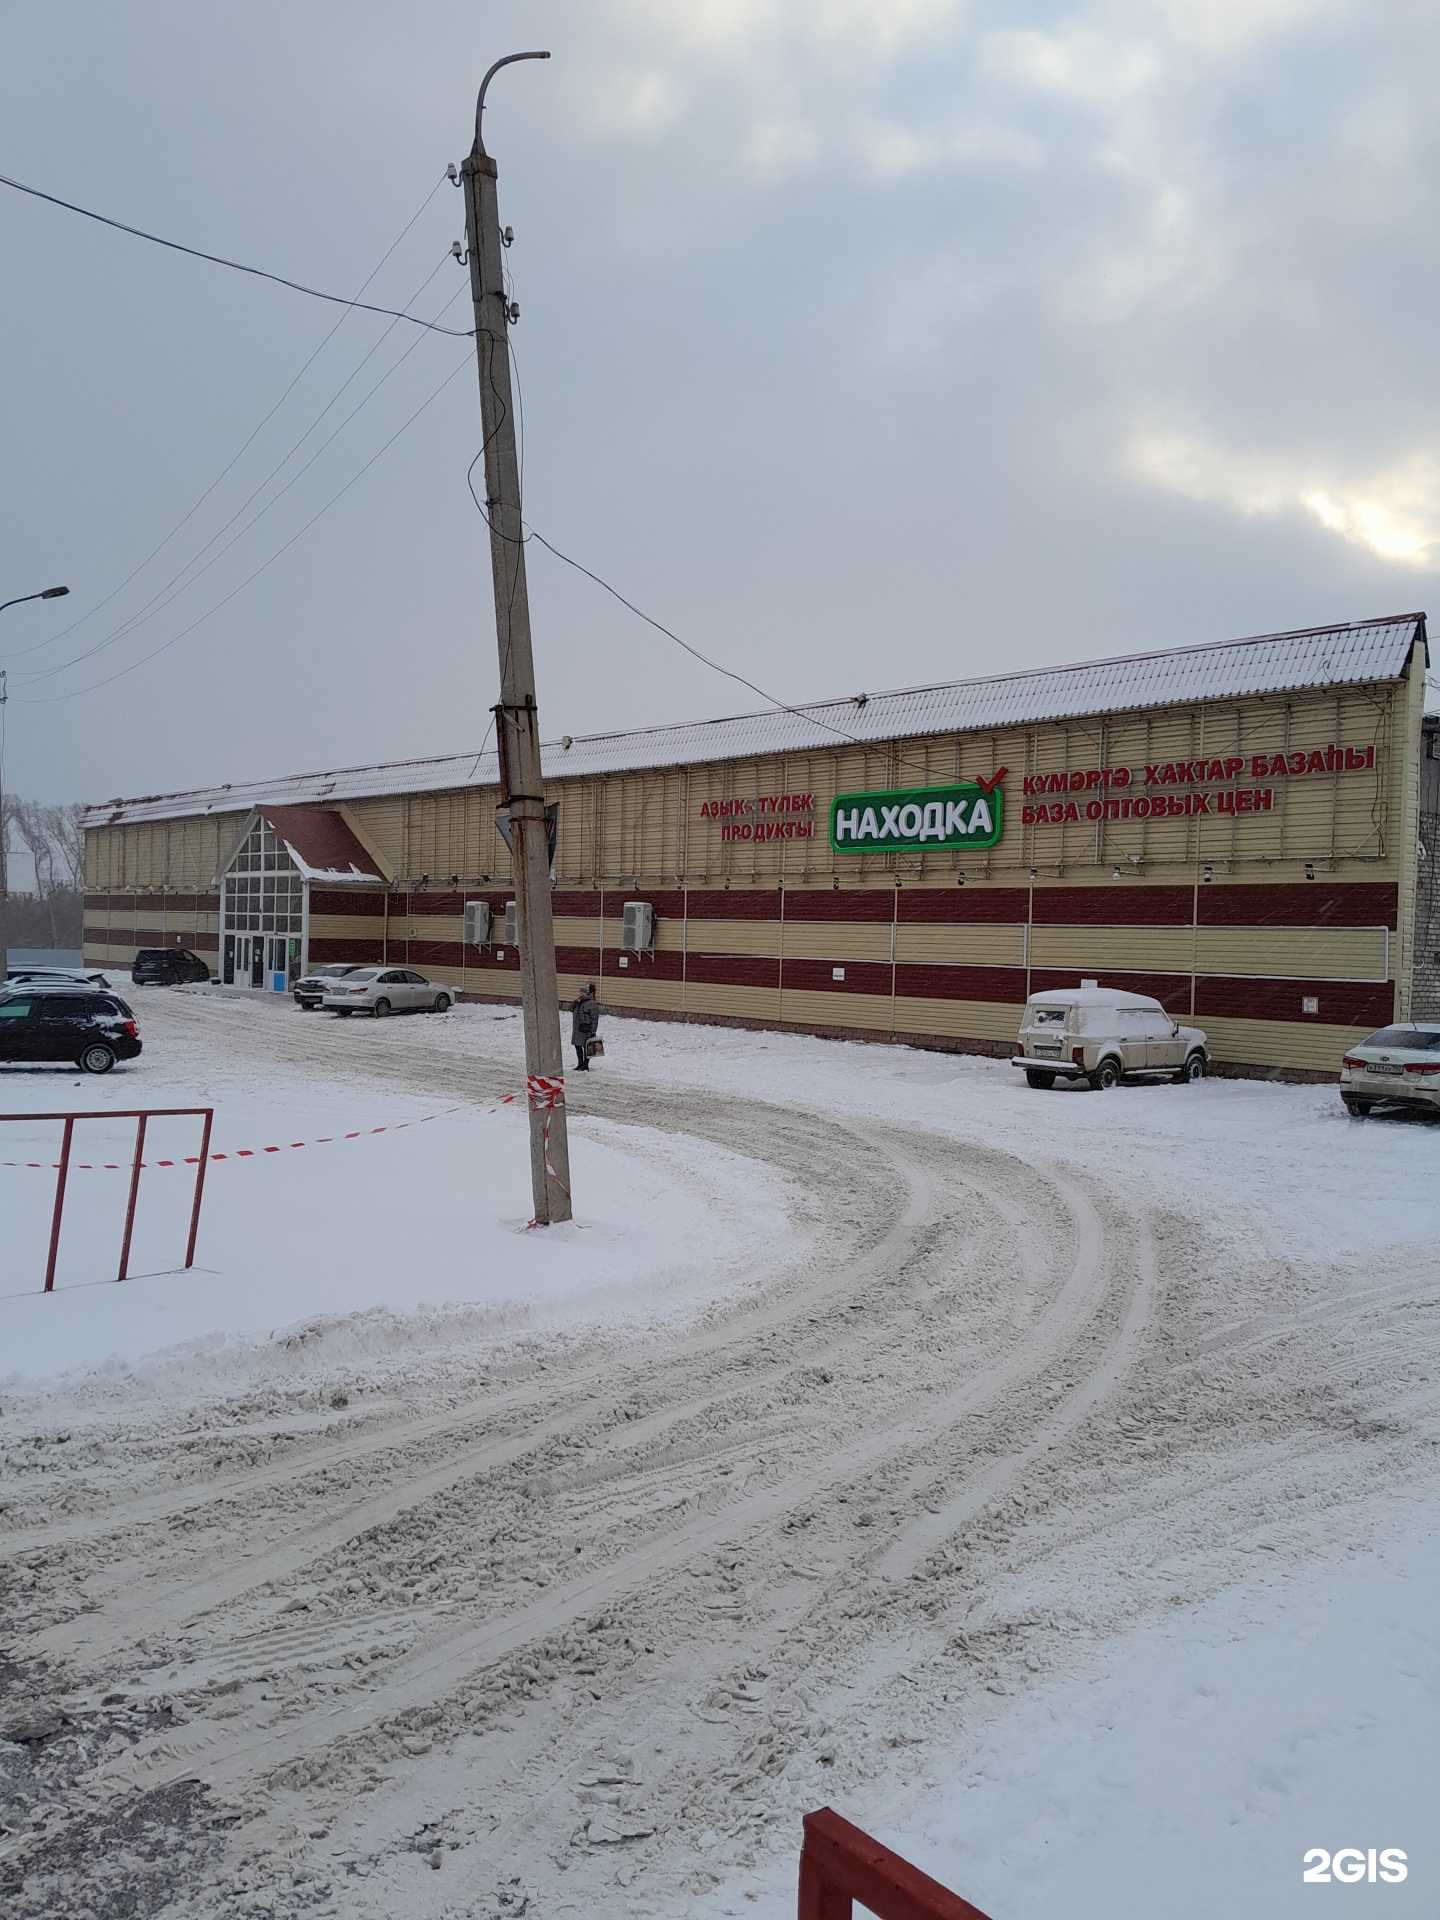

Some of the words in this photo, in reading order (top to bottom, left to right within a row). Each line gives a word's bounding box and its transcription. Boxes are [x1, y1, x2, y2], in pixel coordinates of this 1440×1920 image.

[836, 798, 994, 842] НАХОДКА
[1022, 801, 1080, 825] БАЗА
[1086, 793, 1211, 821] ОПТОВЫХ
[1217, 788, 1274, 816] ЦЕН
[721, 820, 816, 842] ПРОДУКТЫ
